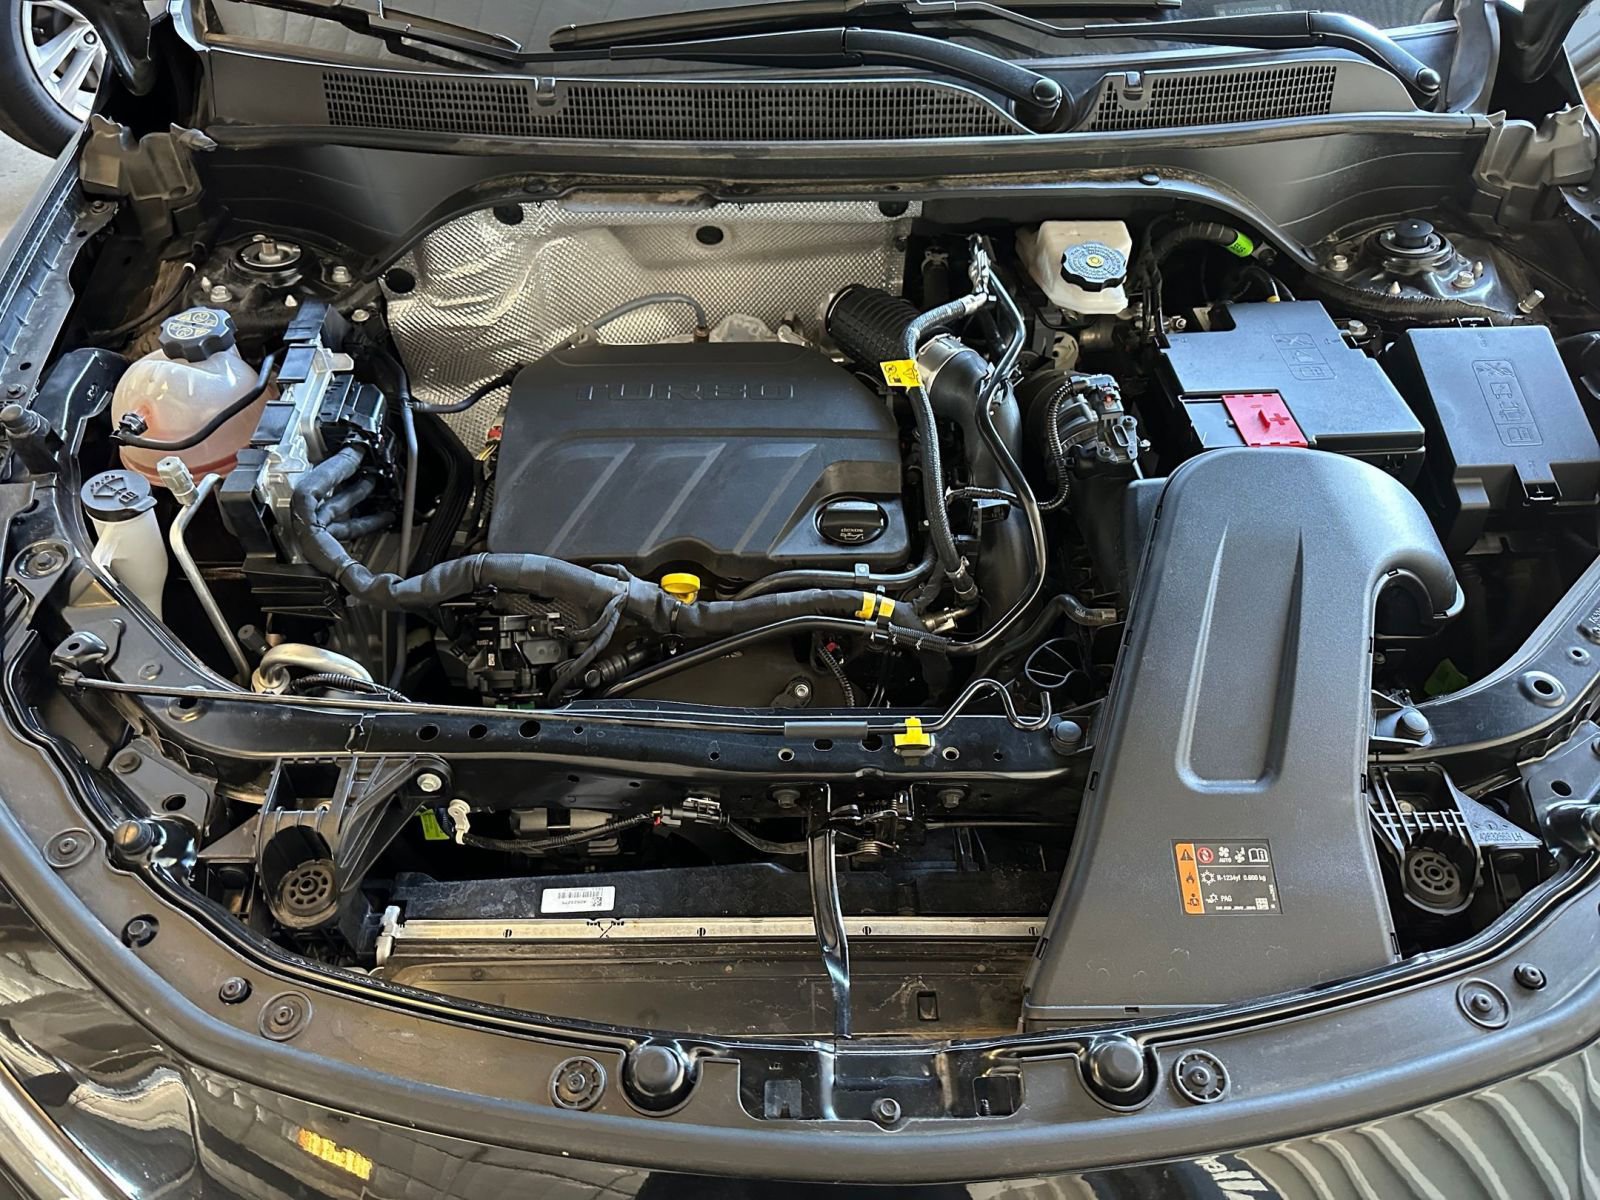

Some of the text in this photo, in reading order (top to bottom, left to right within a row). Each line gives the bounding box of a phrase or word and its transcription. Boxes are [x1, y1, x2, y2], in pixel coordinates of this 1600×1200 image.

[575, 384, 799, 401] TURBO
[1216, 874, 1241, 882] R-1234yf
[1259, 874, 1267, 882] kg
